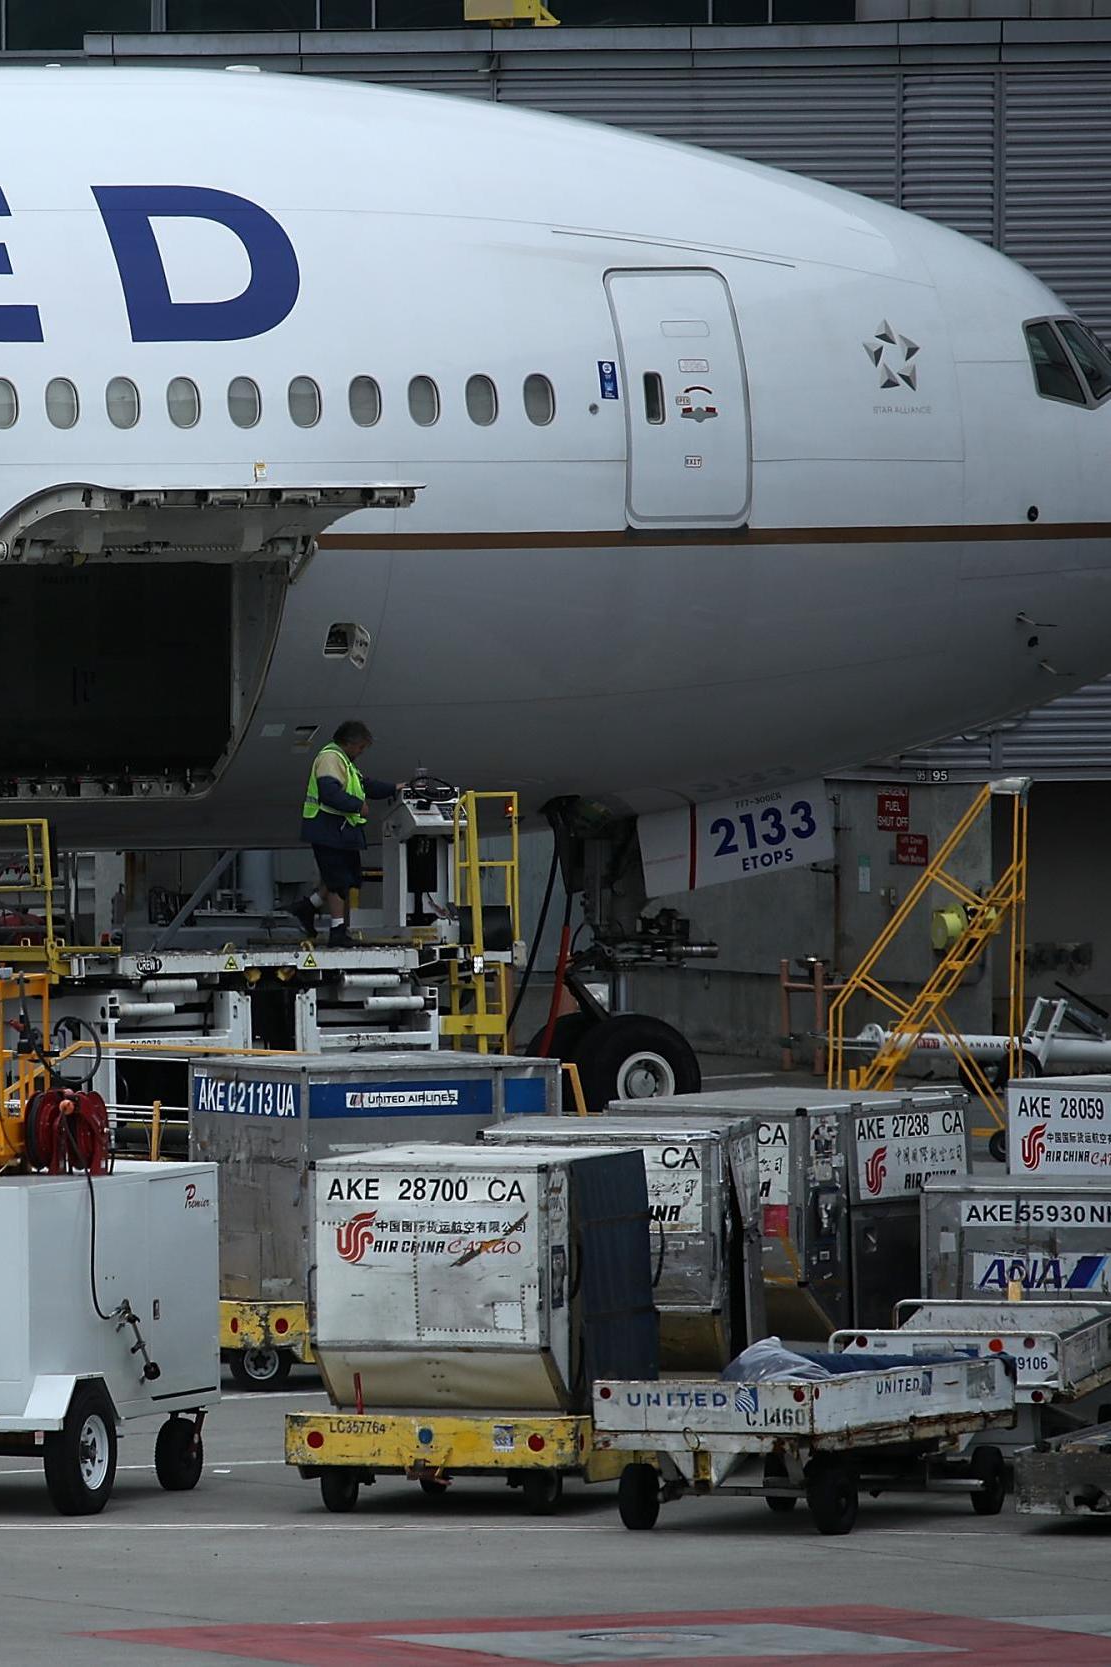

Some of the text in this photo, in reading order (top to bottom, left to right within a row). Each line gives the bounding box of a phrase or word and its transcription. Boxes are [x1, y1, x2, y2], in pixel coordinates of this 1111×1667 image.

[686, 458, 701, 466] EXIT
[932, 770, 948, 781] 95
[885, 801, 901, 812] FUEL
[710, 800, 817, 857] 2133
[878, 816, 909, 827] SHUT OFF
[742, 848, 794, 872] ETOPS
[969, 1041, 1001, 1049] ANADA
[199, 1078, 225, 1112] AKE
[276, 1084, 296, 1117] UA
[368, 1092, 456, 1105] UNITED AIRLINES
[1018, 1096, 1104, 1120] AKE 28059
[757, 1124, 787, 1145] CA
[857, 1111, 963, 1140] AKE 27238 CA
[661, 1146, 700, 1169] CA
[1046, 1150, 1061, 1162] AIR
[1063, 1150, 1090, 1162] CHINA
[327, 1178, 526, 1203] AKE 28700 CA
[650, 1205, 681, 1222] INA
[966, 1204, 1013, 1222] AKE
[1019, 1205, 1086, 1223] 55930
[373, 1240, 397, 1253] AIR
[401, 1240, 445, 1254] CHINA
[979, 1259, 1062, 1289] ANA
[876, 1377, 920, 1395] UNITED
[627, 1392, 727, 1407] UNITED
